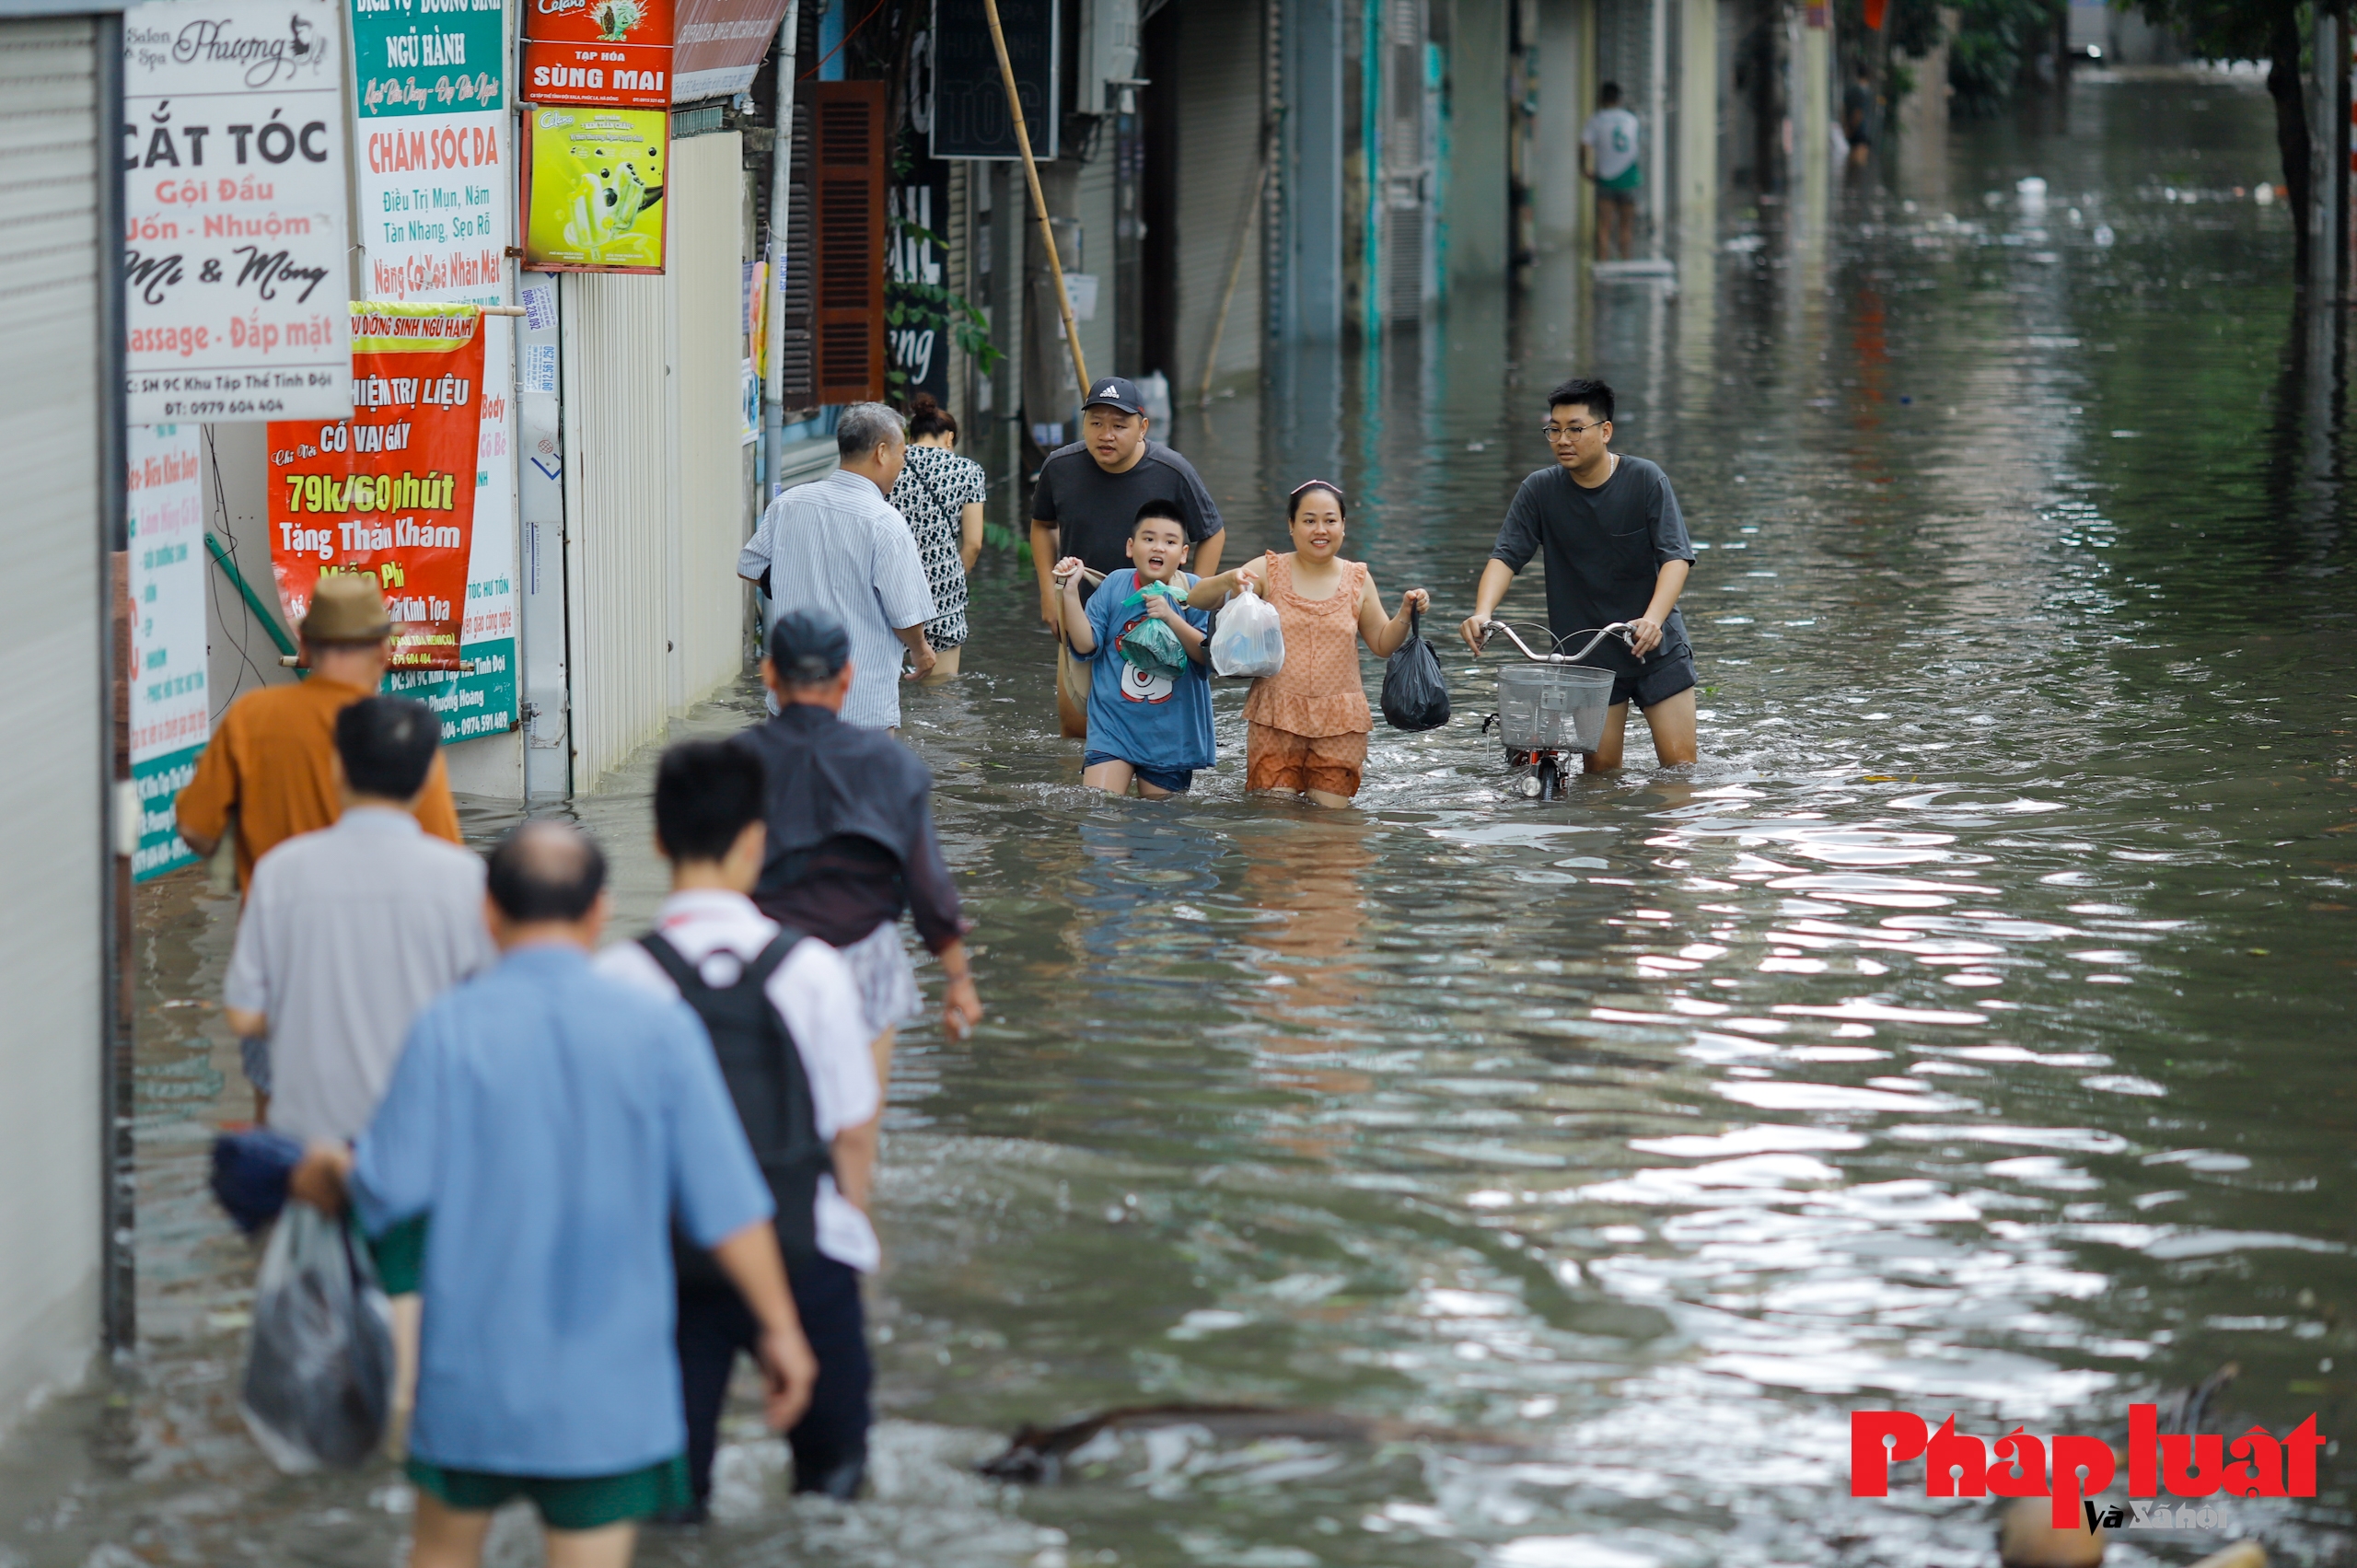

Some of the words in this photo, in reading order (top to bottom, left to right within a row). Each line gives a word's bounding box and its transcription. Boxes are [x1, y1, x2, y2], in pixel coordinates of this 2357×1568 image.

[127, 28, 170, 43] Salon
[386, 26, 419, 68] NGŨ
[422, 25, 466, 66] HÀNH
[139, 48, 166, 72] Spa
[172, 18, 296, 88] Phượng
[575, 51, 598, 62] TẠP
[601, 51, 625, 62] HÓA
[534, 63, 603, 88] SÙNG
[612, 69, 664, 90] MAI
[123, 100, 209, 168] CẮT
[227, 108, 327, 164] TÓC
[540, 111, 574, 129] Celano
[369, 128, 427, 174] CHĂM
[431, 124, 469, 169] SÓC
[156, 180, 208, 208] Gội
[383, 188, 409, 213] Điều
[412, 189, 428, 213] Trị
[433, 187, 461, 211] Mụn,
[465, 185, 489, 206] Nám
[204, 212, 310, 241] Nhuộm
[384, 222, 404, 243] Tàn
[409, 220, 448, 243] Nhang,
[453, 216, 472, 241] Sẹo
[199, 259, 223, 283] &
[233, 245, 328, 304] Móng
[374, 259, 404, 300] Nâng
[450, 251, 479, 287] Nhăn
[482, 249, 500, 288] Mặt
[126, 326, 208, 357] assage
[230, 307, 278, 354] Đắp
[286, 314, 331, 354] mặt
[393, 317, 419, 336] SINH
[422, 315, 443, 337] NGŨ
[542, 345, 554, 391] 0912.561.250
[185, 377, 211, 390] Khu
[391, 377, 419, 410] TRỊ
[422, 373, 470, 411] LIỆU
[191, 400, 224, 414] 0979
[229, 398, 254, 412] 604
[259, 398, 284, 412] 404
[482, 392, 505, 424] Body
[354, 424, 384, 452] VAI
[385, 418, 412, 451] GÁY
[480, 433, 492, 458] Cô
[494, 431, 506, 456] Bé
[286, 474, 390, 513] 79k/60
[391, 471, 454, 514] phút
[279, 522, 333, 561] Tặng
[395, 517, 460, 549] Khám
[381, 561, 405, 589] Phí
[468, 579, 482, 599] TÓC
[483, 578, 493, 597] HƯ
[403, 596, 426, 621] Kinh
[428, 596, 450, 627] Tọa
[493, 655, 505, 673] Đội
[428, 693, 459, 713] Phượng
[461, 715, 480, 737] 0974
[481, 714, 493, 732] 591
[494, 711, 507, 727] 489
